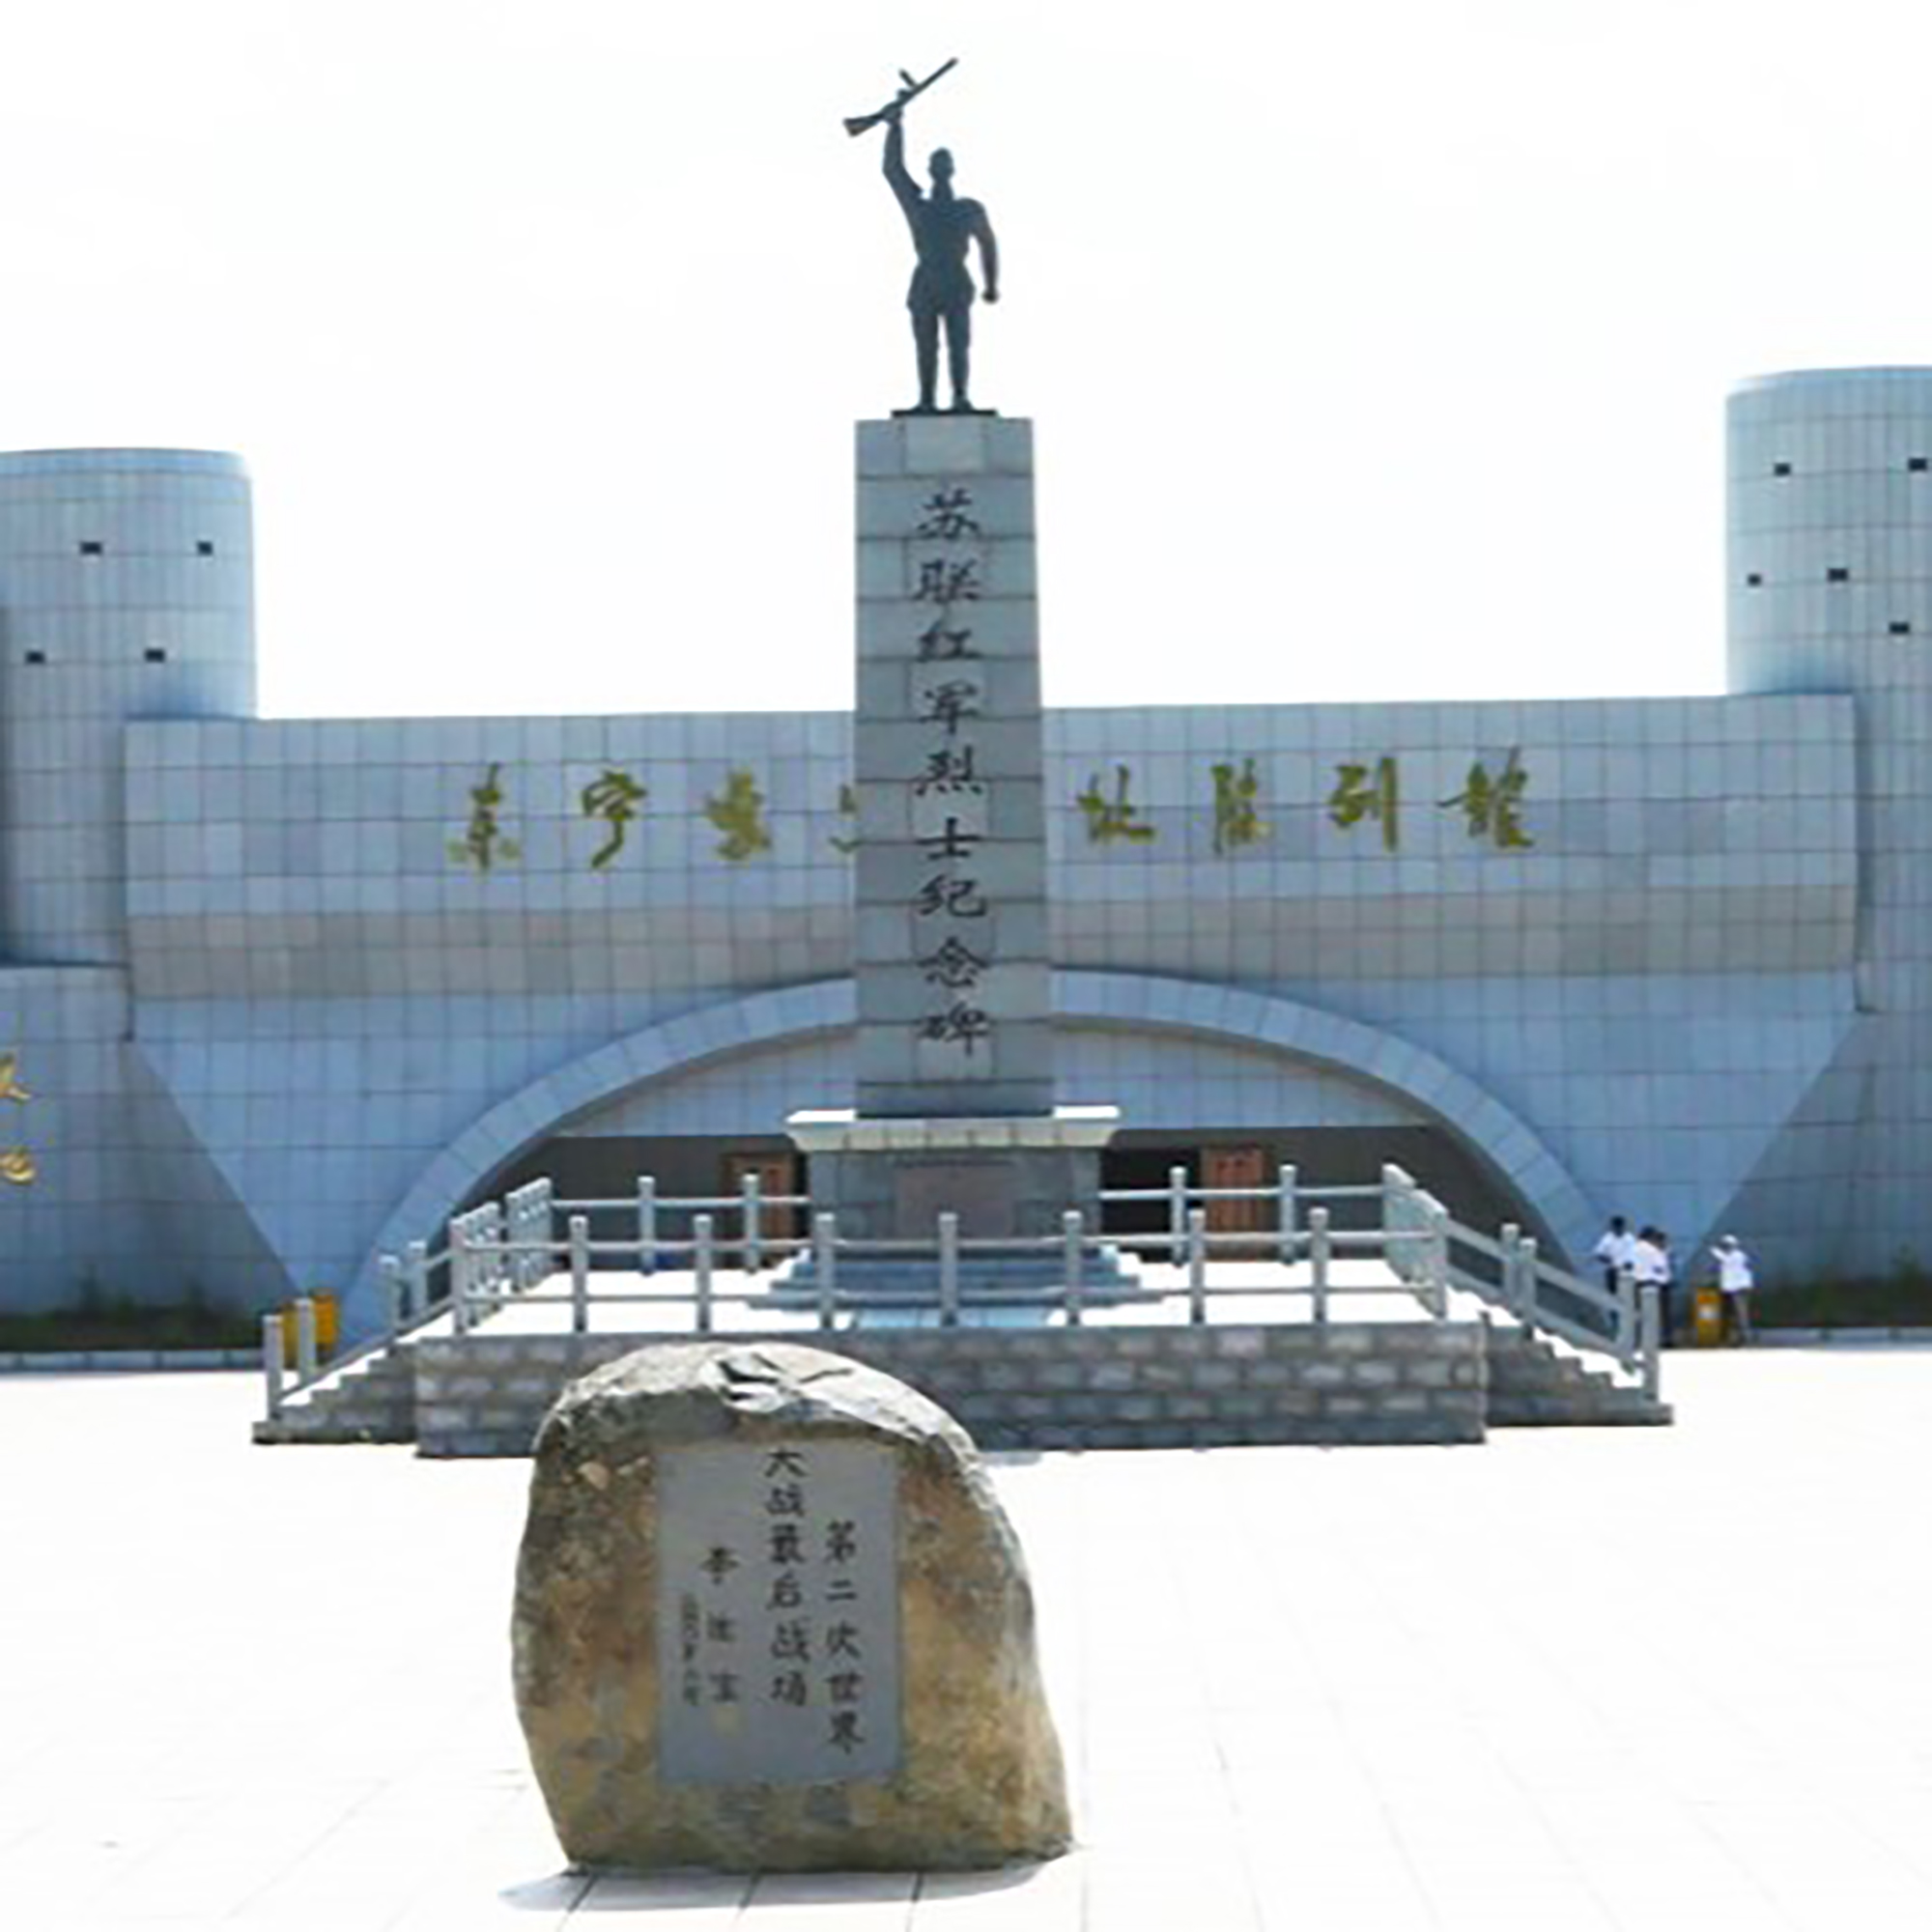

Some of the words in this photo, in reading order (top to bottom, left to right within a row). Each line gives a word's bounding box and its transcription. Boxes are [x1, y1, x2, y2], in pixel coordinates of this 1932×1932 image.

[917, 486, 989, 1058] 苏联红军烈士纪念碑
[824, 1520, 866, 1754] 第二次世界
